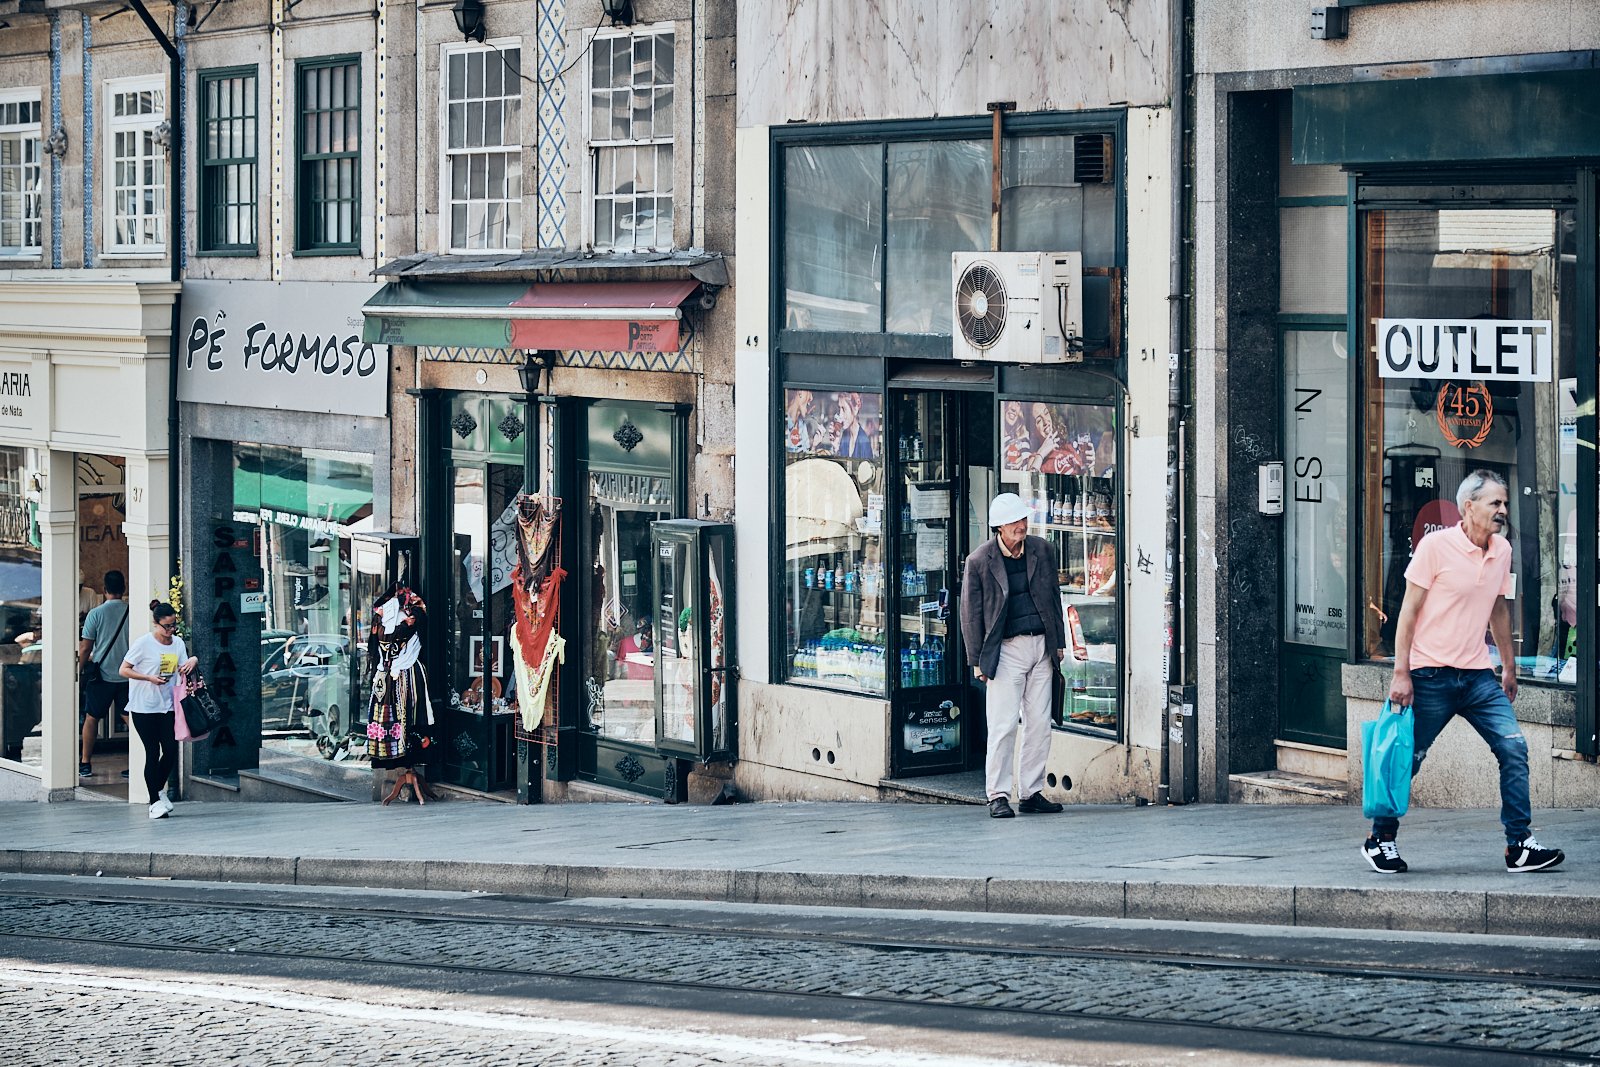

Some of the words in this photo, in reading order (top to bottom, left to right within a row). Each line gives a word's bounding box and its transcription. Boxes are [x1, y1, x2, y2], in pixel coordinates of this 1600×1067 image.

[346, 316, 365, 329] Sapata
[243, 322, 376, 377] FORMOSO
[1385, 324, 1547, 375] OUTLET
[0, 372, 31, 397] ARIA
[10, 405, 23, 417] Nata
[1450, 387, 1480, 417] 45
[1446, 417, 1482, 427] ANNIVERSARY
[133, 487, 143, 503] 37
[294, 577, 304, 604] Wrangler
